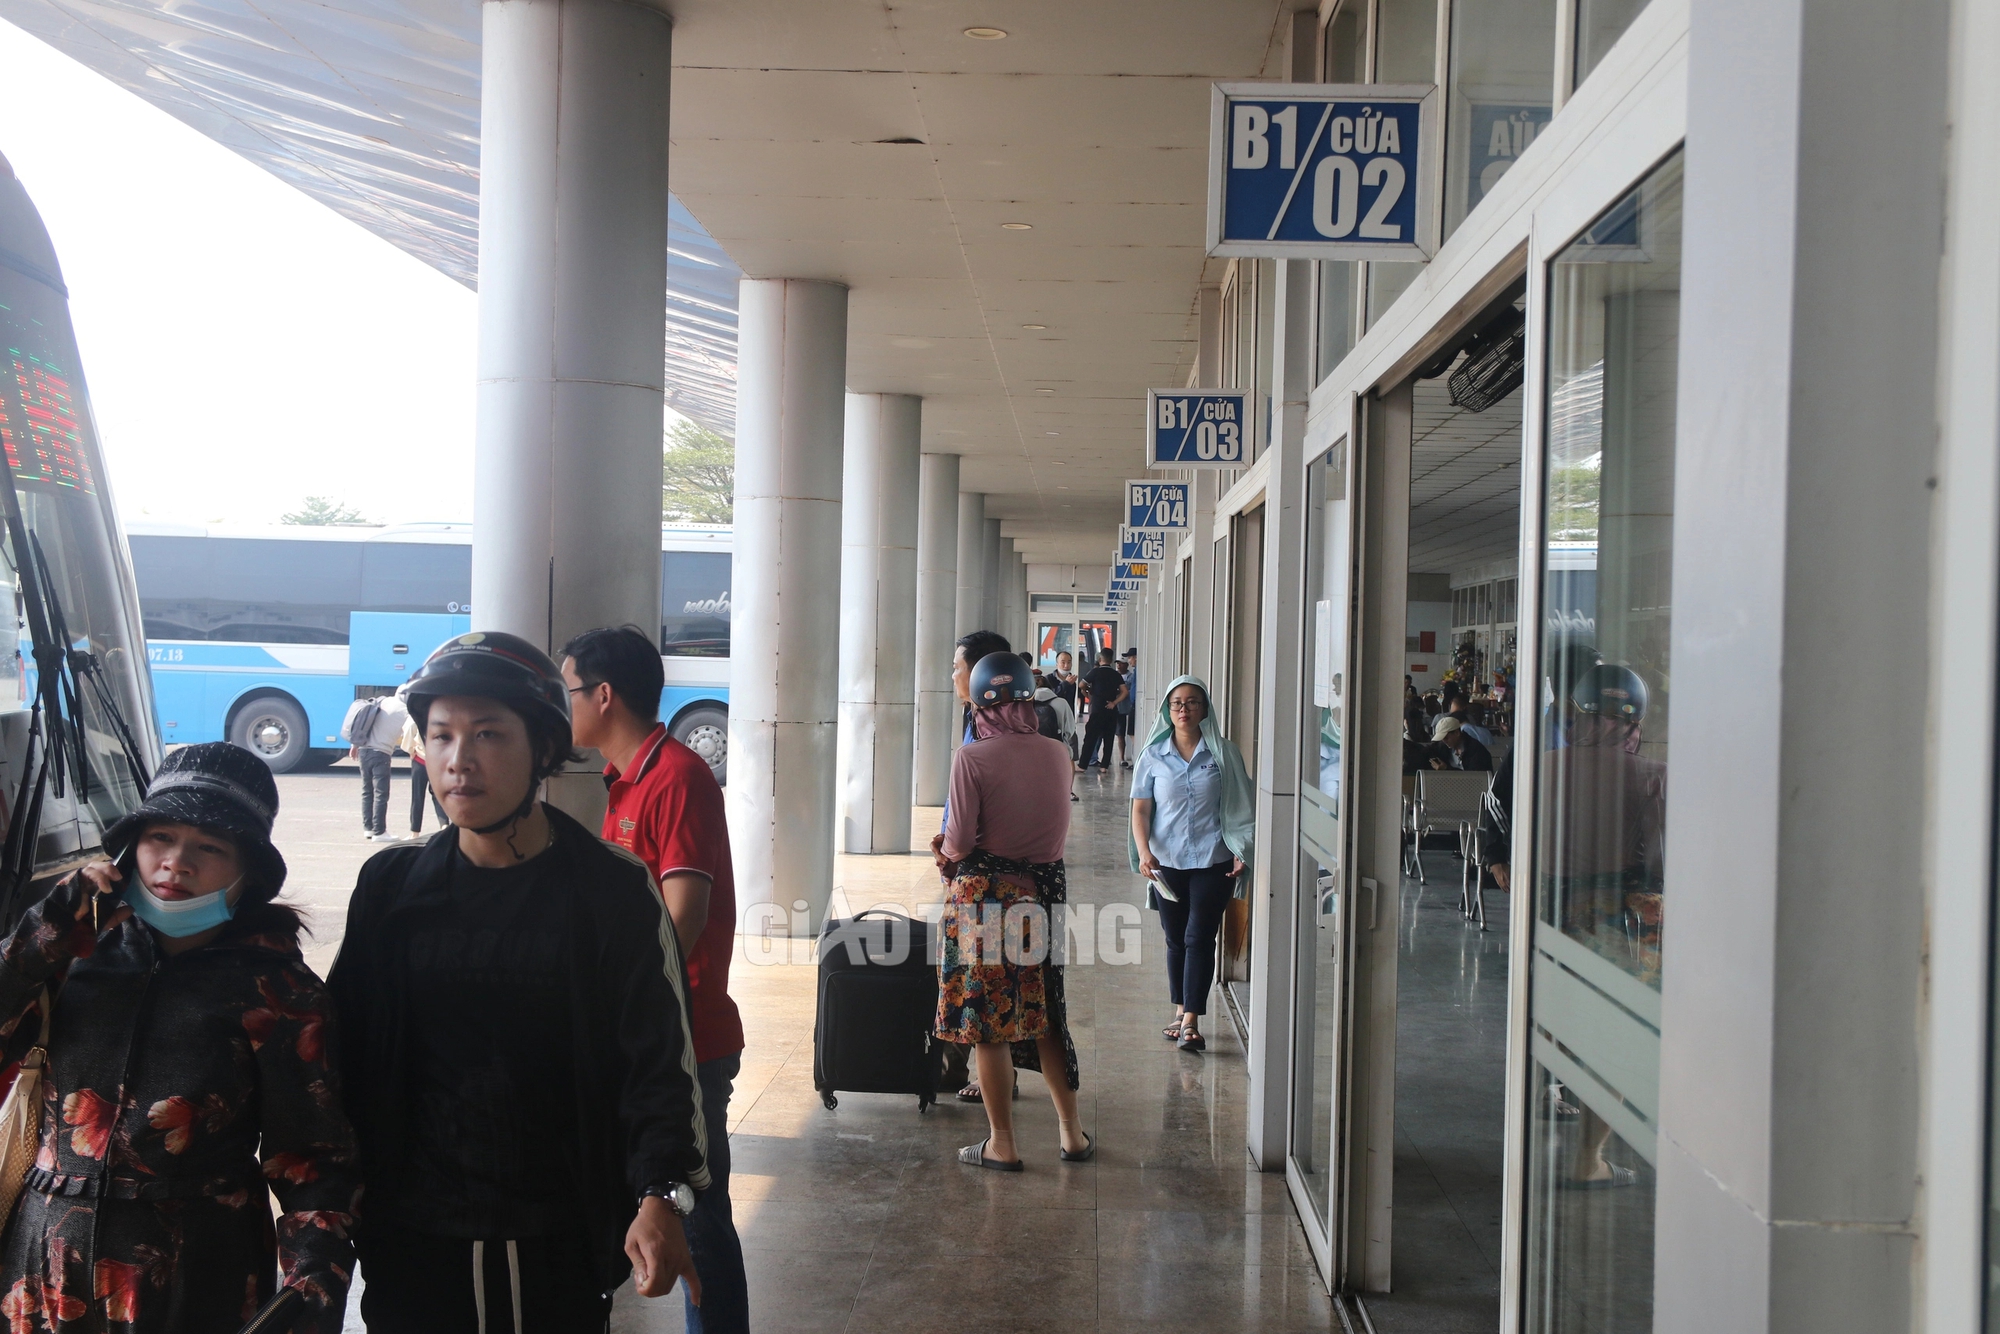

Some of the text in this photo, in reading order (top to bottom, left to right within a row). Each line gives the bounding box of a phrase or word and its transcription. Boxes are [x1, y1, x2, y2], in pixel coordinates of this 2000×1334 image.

[1233, 105, 1400, 169] B1 CỬA
[1313, 156, 1406, 239] 02
[1159, 398, 1235, 429] B1 CỬA
[1196, 421, 1239, 460] 03
[1132, 486, 1183, 506] B1 CỬA
[1156, 500, 1186, 526] 04
[1142, 540, 1163, 559] 05
[1131, 564, 1148, 576] WC
